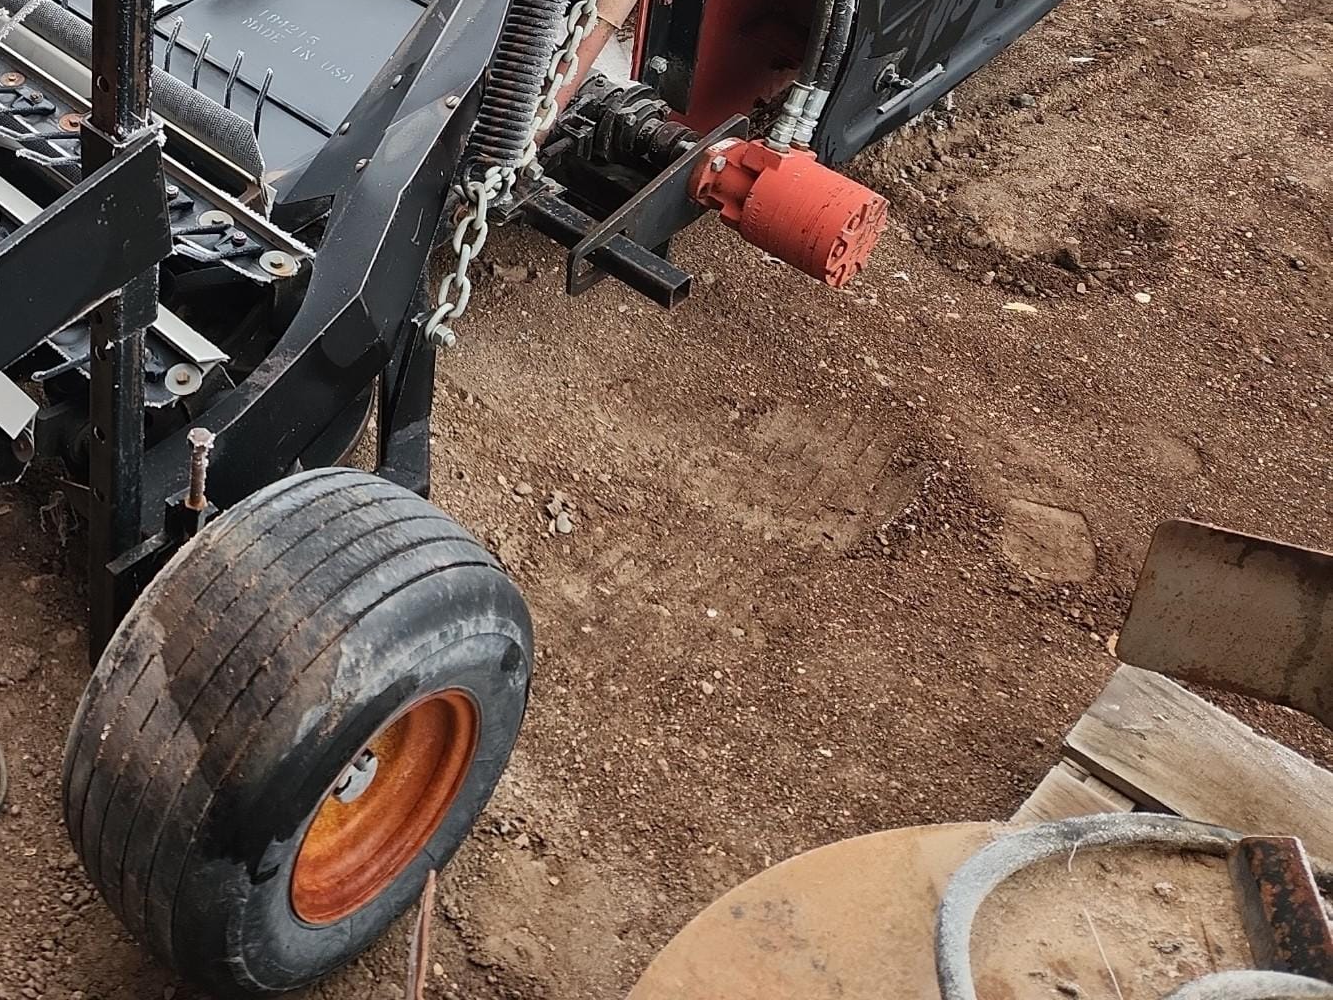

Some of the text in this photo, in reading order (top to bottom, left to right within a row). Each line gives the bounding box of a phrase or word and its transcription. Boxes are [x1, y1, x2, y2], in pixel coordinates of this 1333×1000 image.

[241, 16, 356, 84] MADE IN USA
